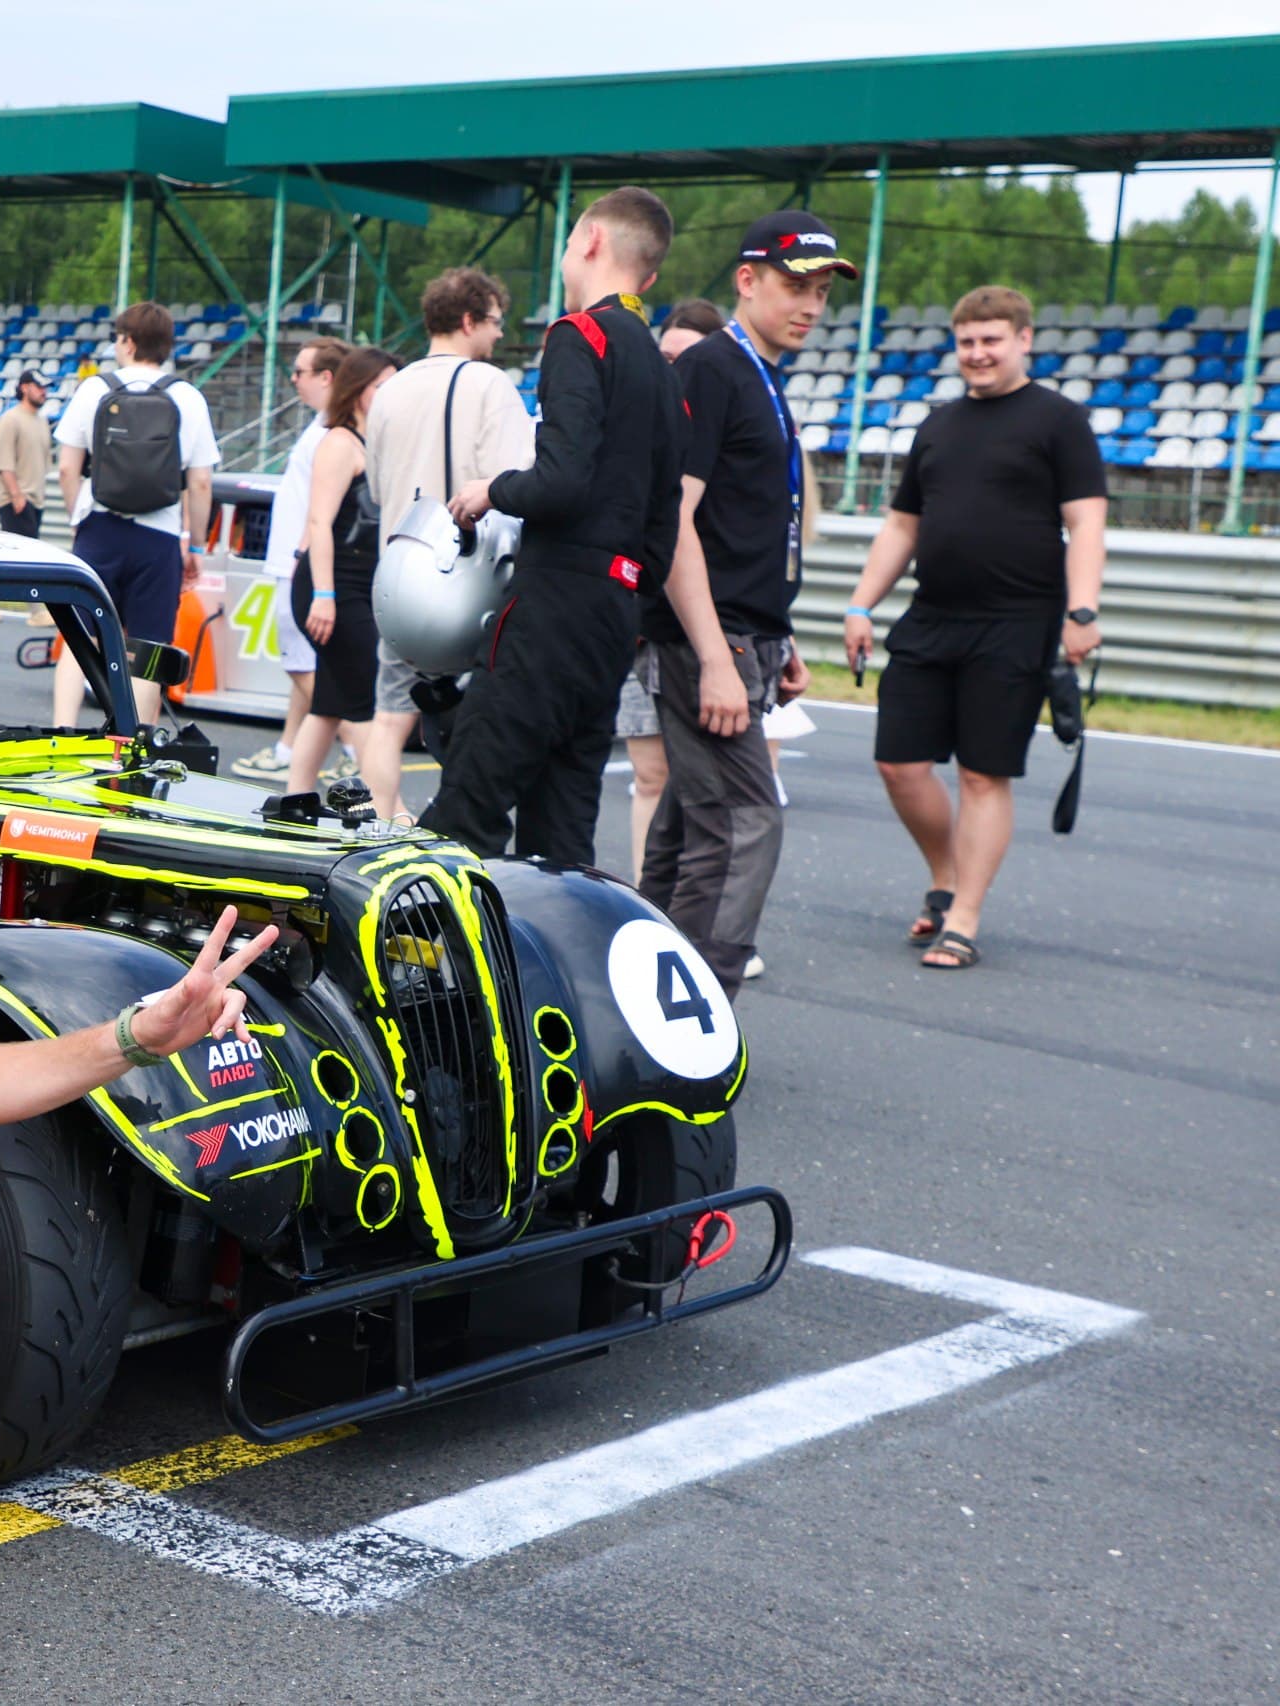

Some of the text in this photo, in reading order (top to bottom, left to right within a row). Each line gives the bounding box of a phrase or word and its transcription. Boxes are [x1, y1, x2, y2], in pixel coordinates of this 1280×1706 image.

[25, 823, 89, 842] ЧЕМПИОНАТ
[656, 950, 716, 1035] 4
[208, 1037, 263, 1071] АВТО
[209, 1062, 256, 1088] ПЛЮС
[229, 1106, 313, 1151] YOKOHAMA
